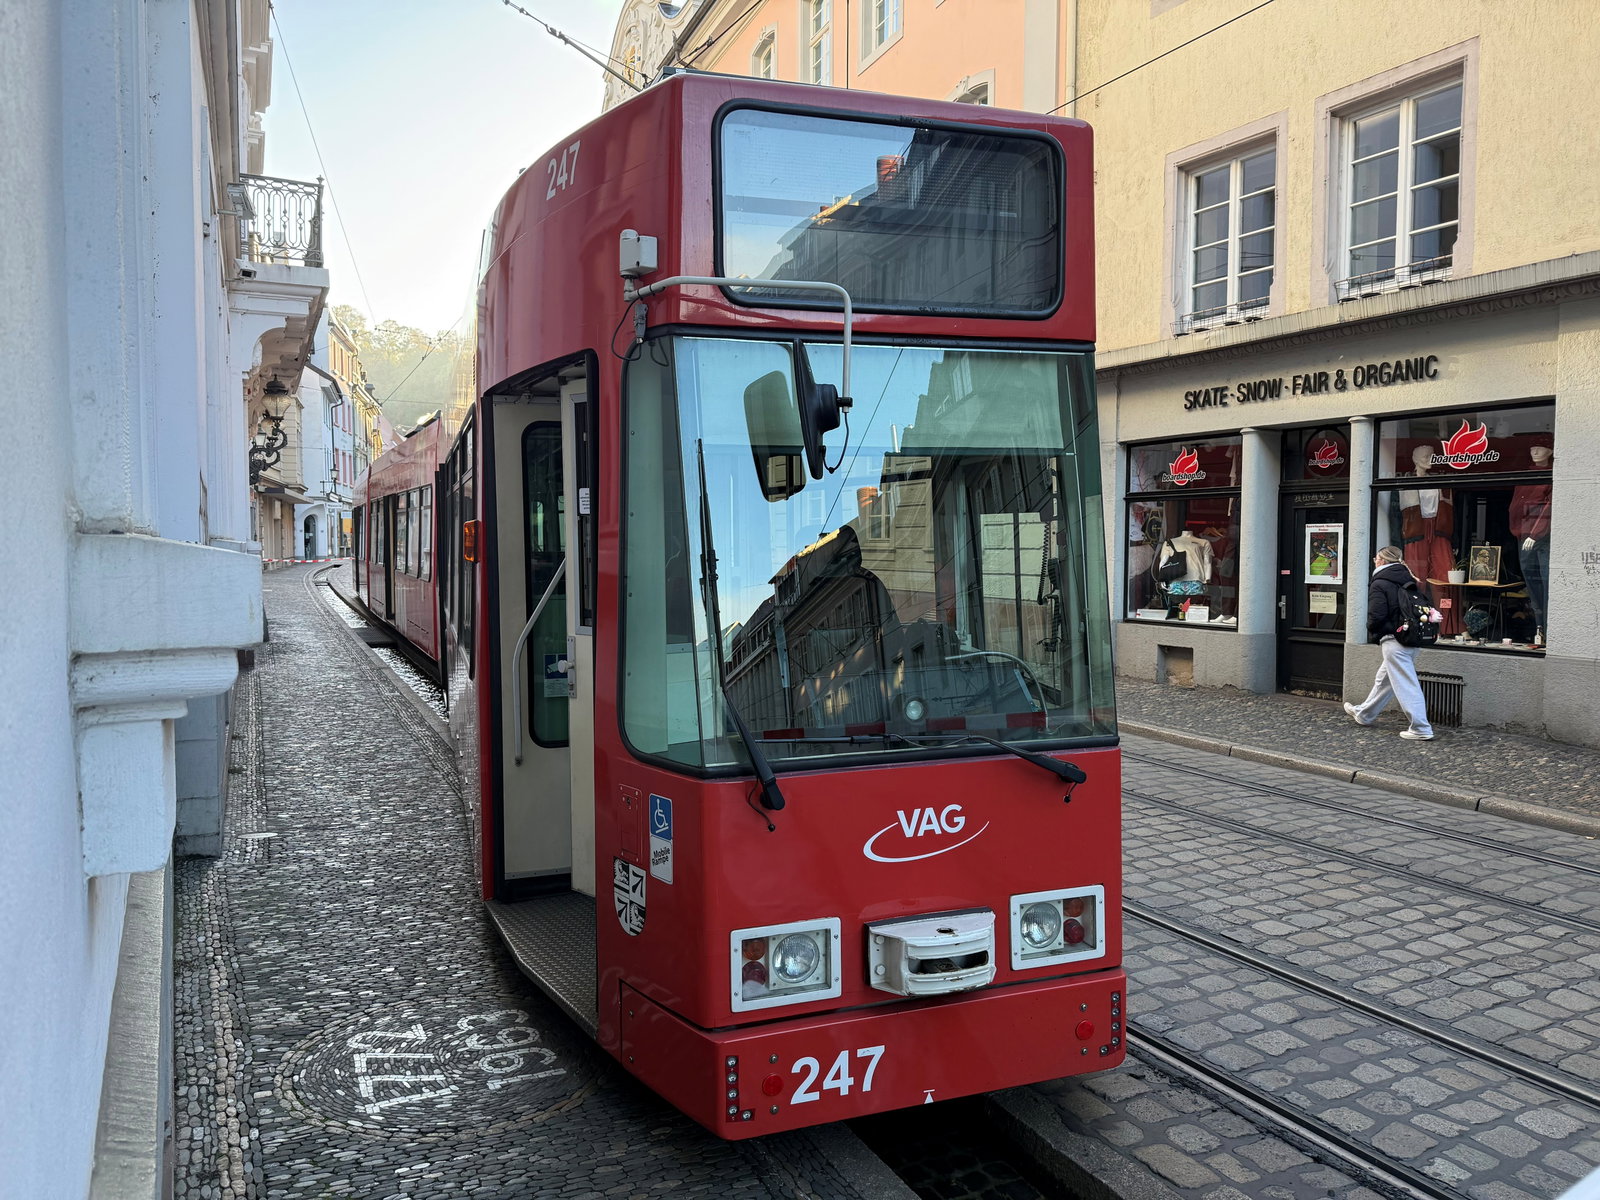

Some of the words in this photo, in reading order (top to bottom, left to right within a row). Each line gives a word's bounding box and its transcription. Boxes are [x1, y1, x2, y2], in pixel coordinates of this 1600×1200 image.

[546, 140, 581, 200] 247
[1184, 386, 1228, 410] SKATE
[1236, 378, 1282, 403] SNOW
[1292, 371, 1329, 395] FAIR
[1334, 368, 1347, 391] &
[1353, 355, 1438, 387] ORGANIC
[1430, 450, 1500, 465] boardshop.de
[1162, 471, 1206, 483] boardshop.de
[896, 804, 966, 838] VAG
[652, 855, 669, 867] Rampe
[653, 847, 671, 859] Mobile
[456, 1009, 567, 1091] 1963
[790, 1045, 885, 1104] 247
